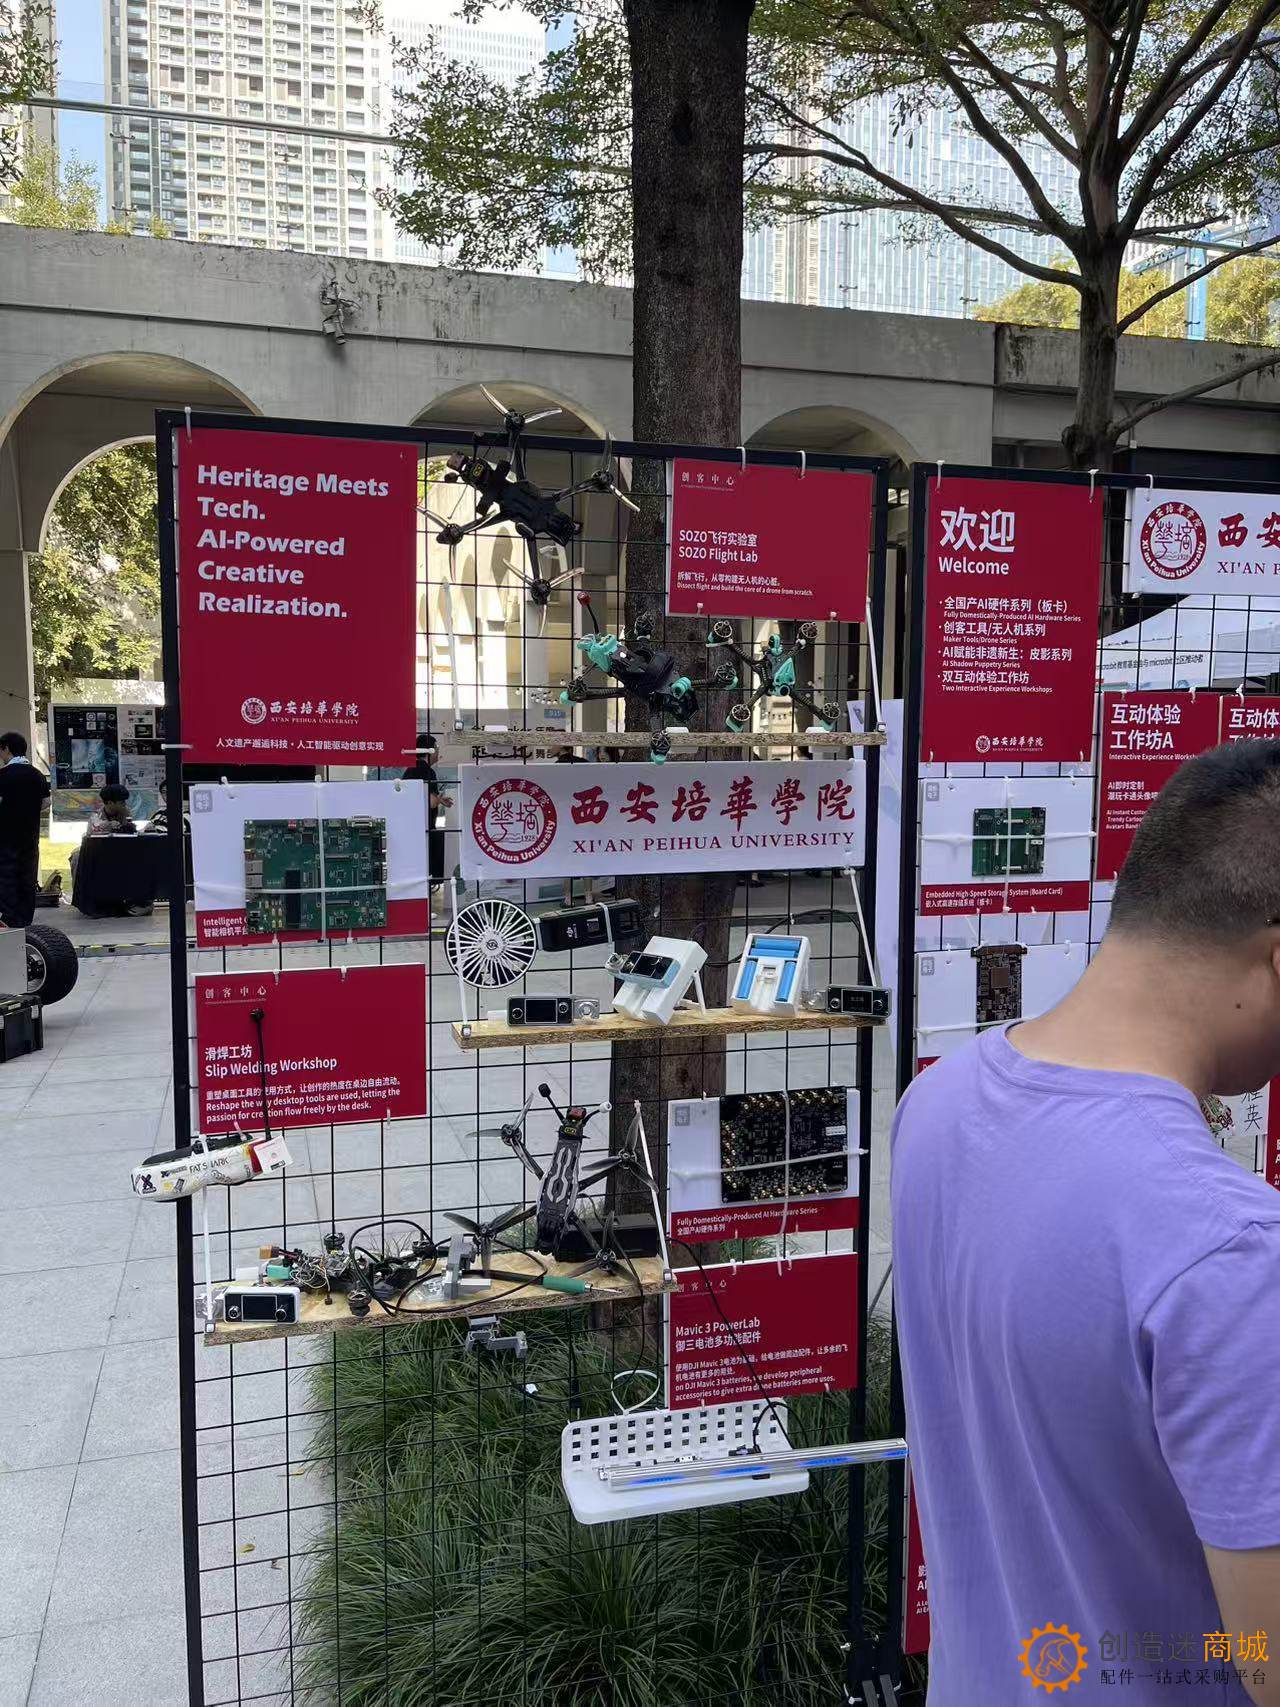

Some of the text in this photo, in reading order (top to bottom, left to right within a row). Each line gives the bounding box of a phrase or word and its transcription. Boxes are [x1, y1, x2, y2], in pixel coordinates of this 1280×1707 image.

[197, 465, 390, 497] Heritage Meets
[197, 497, 266, 519] Tech.
[679, 530, 758, 548] SOZO飞行实验室
[939, 506, 1016, 553] 欢迎
[1218, 511, 1280, 549] 西安
[196, 529, 345, 555] AI-Powered
[678, 546, 758, 564] SOZO Flight Lab
[197, 561, 304, 585] Creative
[938, 557, 1010, 575] Welcome
[1217, 562, 1266, 576] XI'AN
[677, 582, 695, 590] Dissect
[696, 583, 710, 592] flight
[721, 584, 734, 592] build
[766, 587, 781, 595] drone
[198, 592, 348, 617] Realization.
[944, 611, 958, 620] Fully
[960, 611, 1027, 622] Domestically-Produced
[1063, 615, 1081, 623] Series
[943, 621, 1046, 637] 创客工具/无人机系列
[943, 636, 1017, 645] Maker Tools/Drone Series
[974, 661, 1001, 670] Puppetry
[942, 671, 1029, 685] 双互动体验工作坊
[956, 685, 988, 693] Interactive
[989, 685, 1020, 694] Experience
[1021, 686, 1052, 694] Workshops
[1111, 704, 1181, 724] 互动体验
[1110, 730, 1175, 750] 工作坊A
[1142, 753, 1174, 761] Experience
[570, 776, 856, 833] 西安培華學院
[572, 832, 855, 854] XI'AN PEIHUA UNIVERSITY
[925, 890, 955, 900] Embedded
[956, 889, 986, 900] High-Speed
[987, 889, 1008, 899] Storag
[1009, 887, 1029, 898] System
[1046, 886, 1064, 897] Card)
[203, 917, 242, 928] Intelligent
[205, 1044, 252, 1060] 滑焊工坊
[205, 1057, 337, 1079] Slip Welding Workshop
[206, 1088, 401, 1113] Reshape the wy desktop tools are used, letting the
[206, 1113, 237, 1125] passion
[238, 1111, 250, 1120] for
[285, 1106, 302, 1117] flow
[303, 1104, 325, 1117] freely
[326, 1103, 337, 1114] by
[337, 1102, 350, 1111] the
[351, 1100, 372, 1110] desk.
[677, 1218, 692, 1228] Fully
[693, 1211, 763, 1225] Domestically-Produced
[763, 1210, 770, 1218] AI
[799, 1207, 818, 1215] Series
[675, 1324, 703, 1338] Mavic
[705, 1322, 711, 1333] 3
[700, 1359, 719, 1371] Mavic
[675, 1383, 684, 1391] on
[685, 1381, 695, 1390] DJI
[696, 1378, 715, 1388] Mavic
[716, 1378, 721, 1386] 3
[722, 1374, 752, 1385] batteries,
[763, 1370, 789, 1383] develop
[789, 1366, 823, 1378] peripheral
[675, 1391, 712, 1402] accessories
[721, 1387, 735, 1397] give
[735, 1384, 752, 1393] extra
[773, 1378, 802, 1389] batteries
[802, 1376, 818, 1385] more
[818, 1374, 836, 1384] uses.
